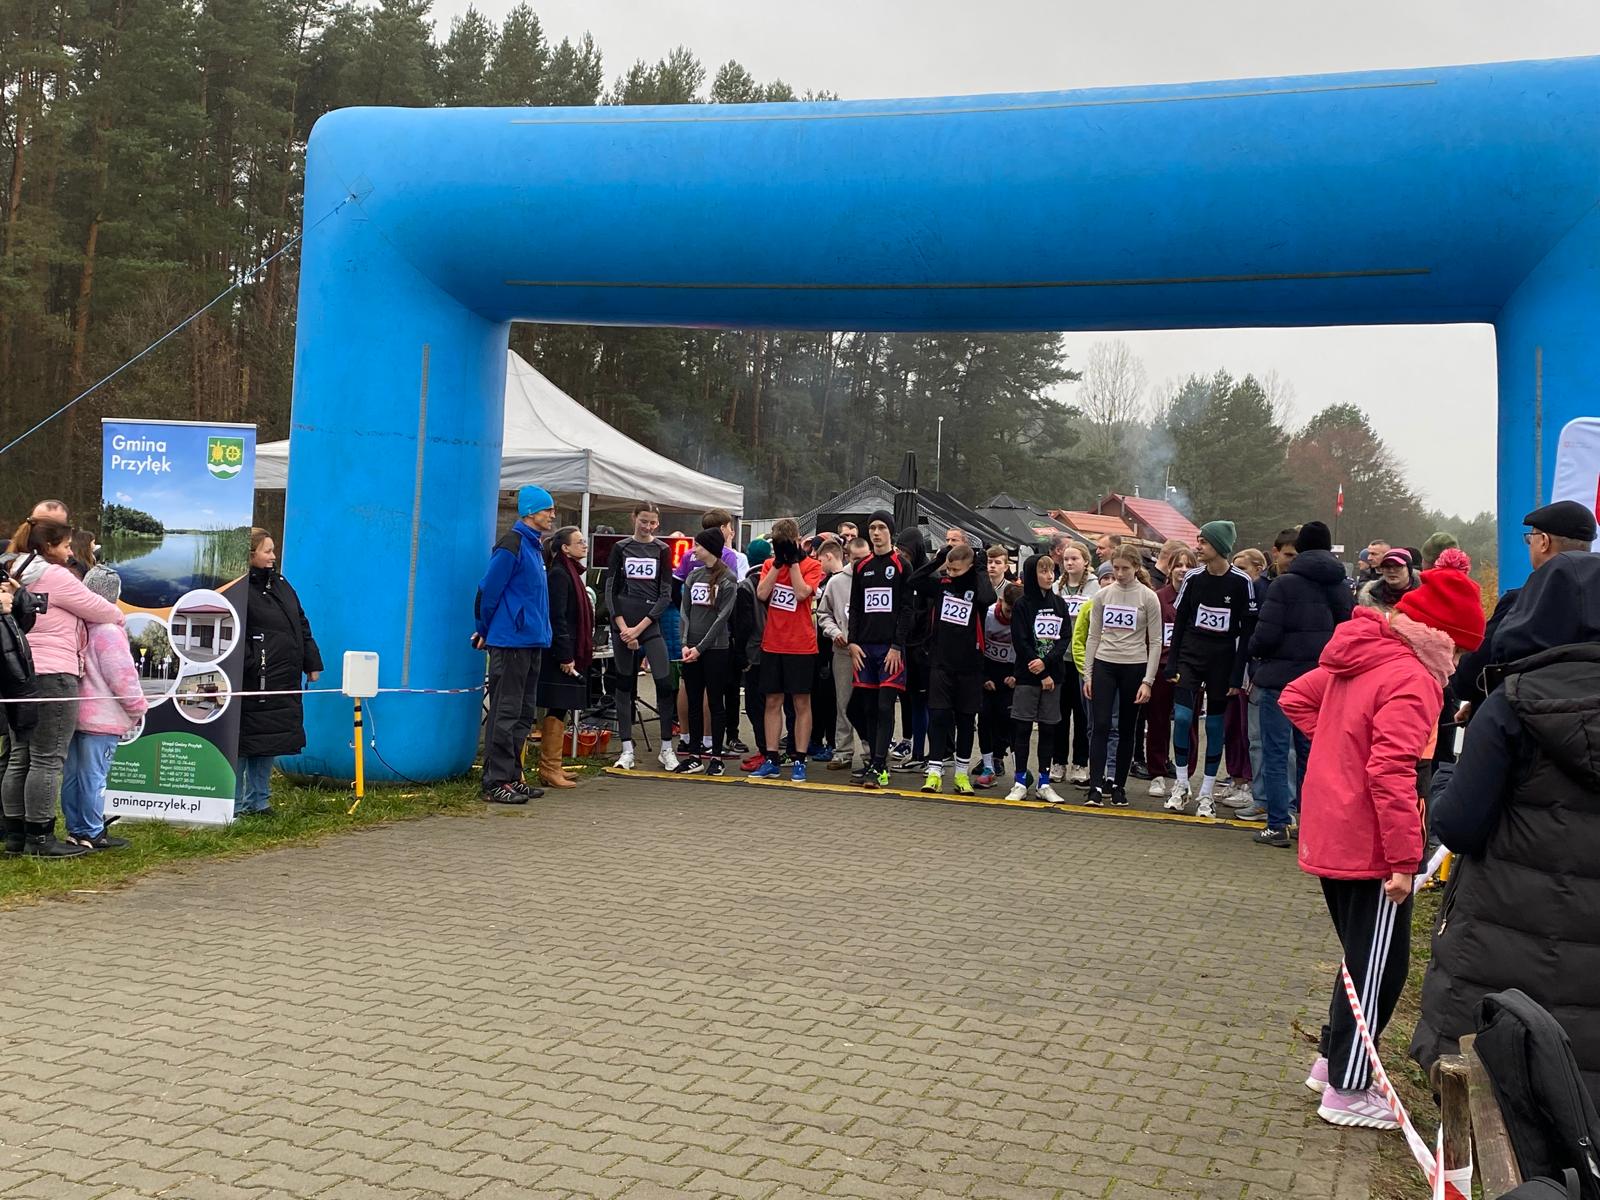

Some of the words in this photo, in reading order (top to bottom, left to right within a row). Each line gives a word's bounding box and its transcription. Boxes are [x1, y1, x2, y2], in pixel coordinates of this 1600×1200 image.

[112, 435, 166, 452] Gmina
[111, 455, 171, 475] Przyłęk
[627, 563, 653, 576] 245
[772, 590, 795, 606] 252
[866, 593, 889, 607] 250
[943, 603, 968, 620] 228
[1104, 611, 1134, 626] 243
[1200, 612, 1225, 628] 231
[985, 643, 1008, 658] 230
[112, 796, 201, 813] gminaprzylek.pl
